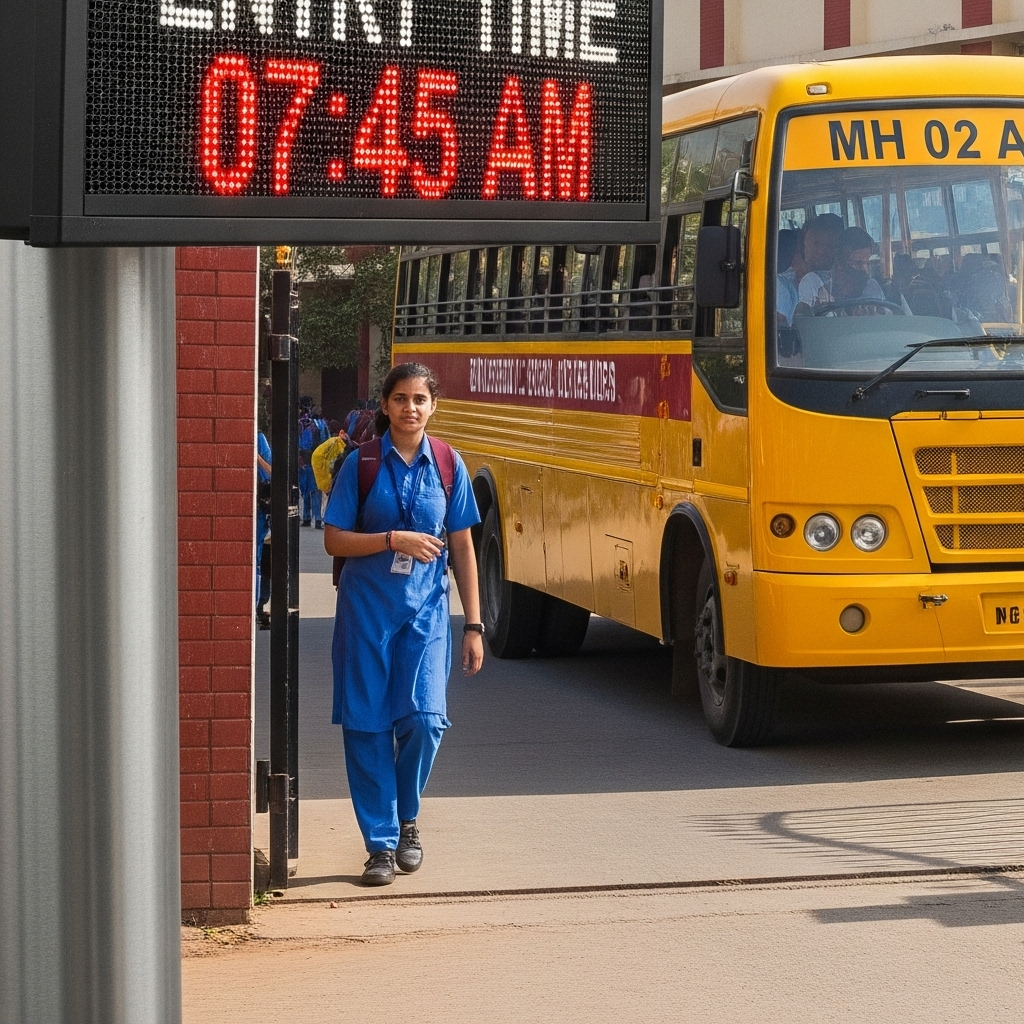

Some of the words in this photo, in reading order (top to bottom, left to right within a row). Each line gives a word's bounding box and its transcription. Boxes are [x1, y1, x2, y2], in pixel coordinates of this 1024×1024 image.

[200, 52, 461, 200] 07:45
[481, 74, 593, 201] AM
[829, 120, 906, 161] MH
[924, 120, 982, 160] 02
